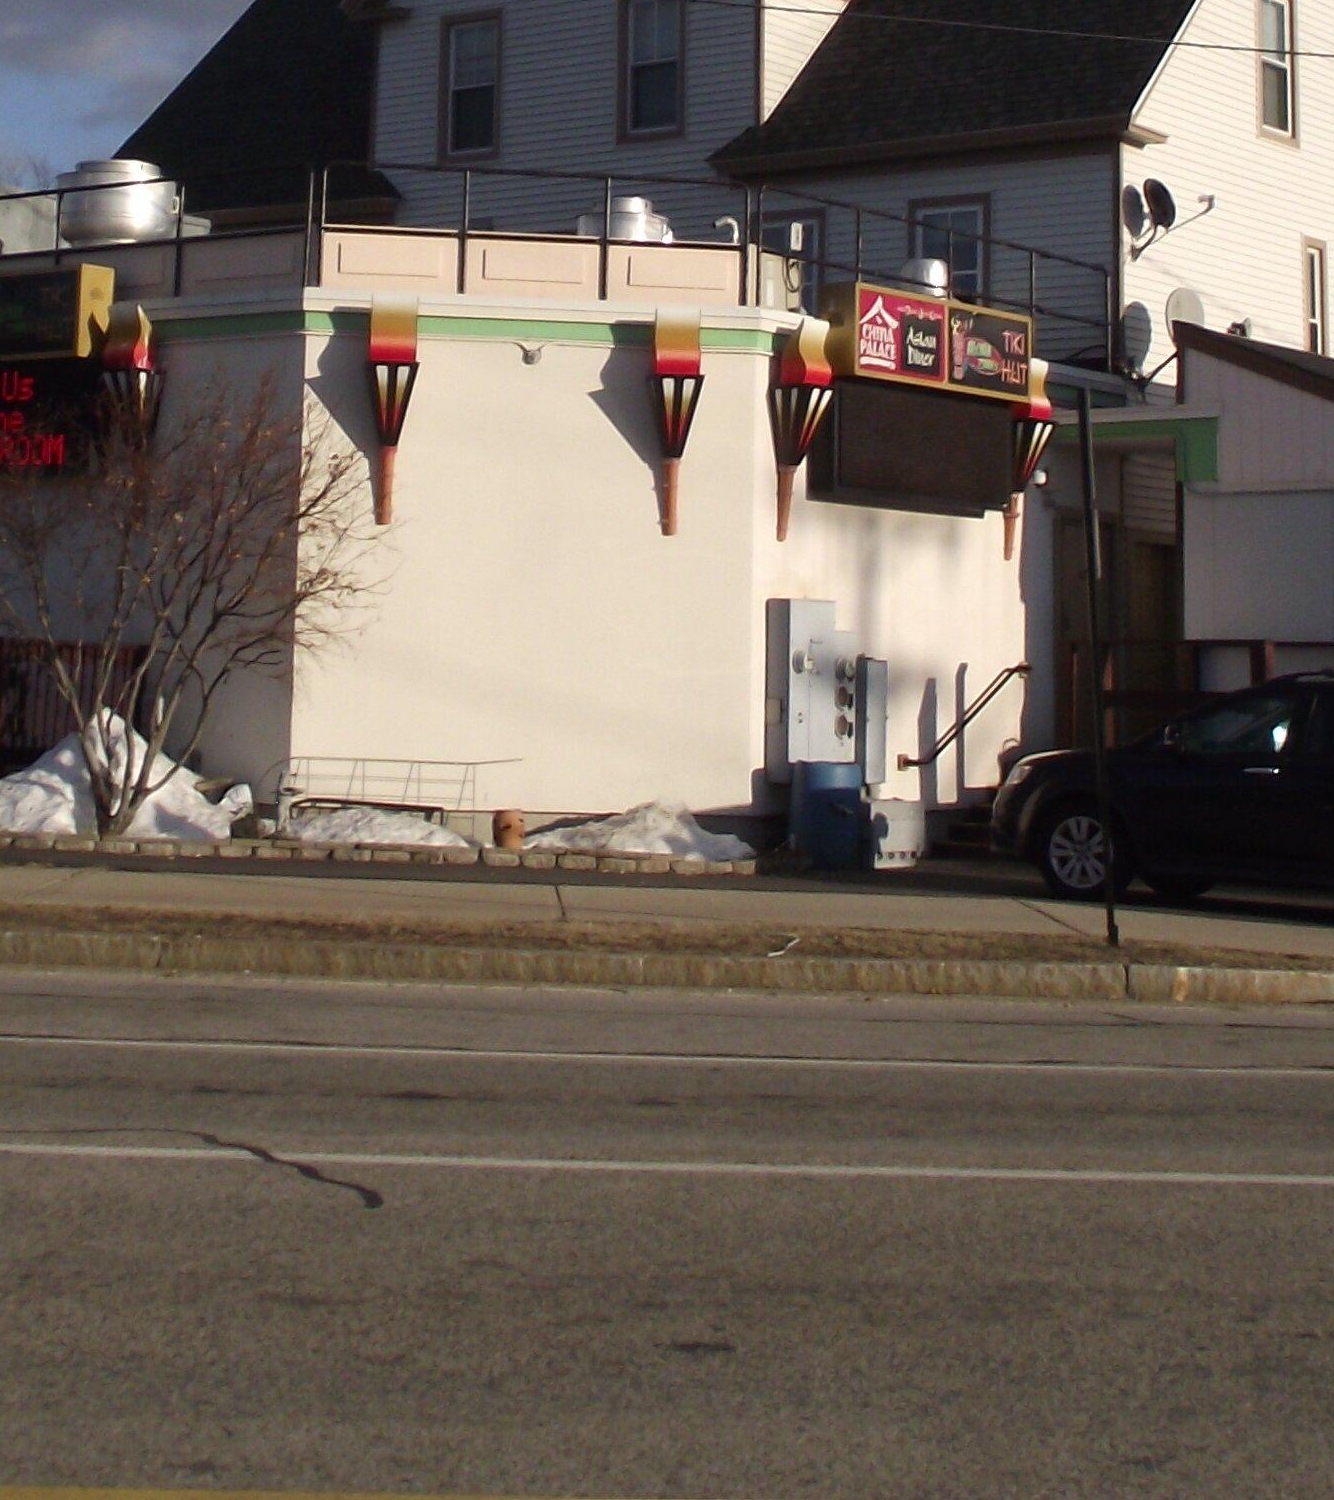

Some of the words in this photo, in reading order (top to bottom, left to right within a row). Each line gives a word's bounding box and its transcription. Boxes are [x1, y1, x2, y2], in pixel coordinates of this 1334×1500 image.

[862, 323, 894, 343] CHINA
[1002, 330, 1025, 355] TIKI
[860, 339, 895, 360] PALACE
[1002, 359, 1027, 384] HUT
[1, 370, 35, 401] Us
[0, 434, 65, 466] ROOM
